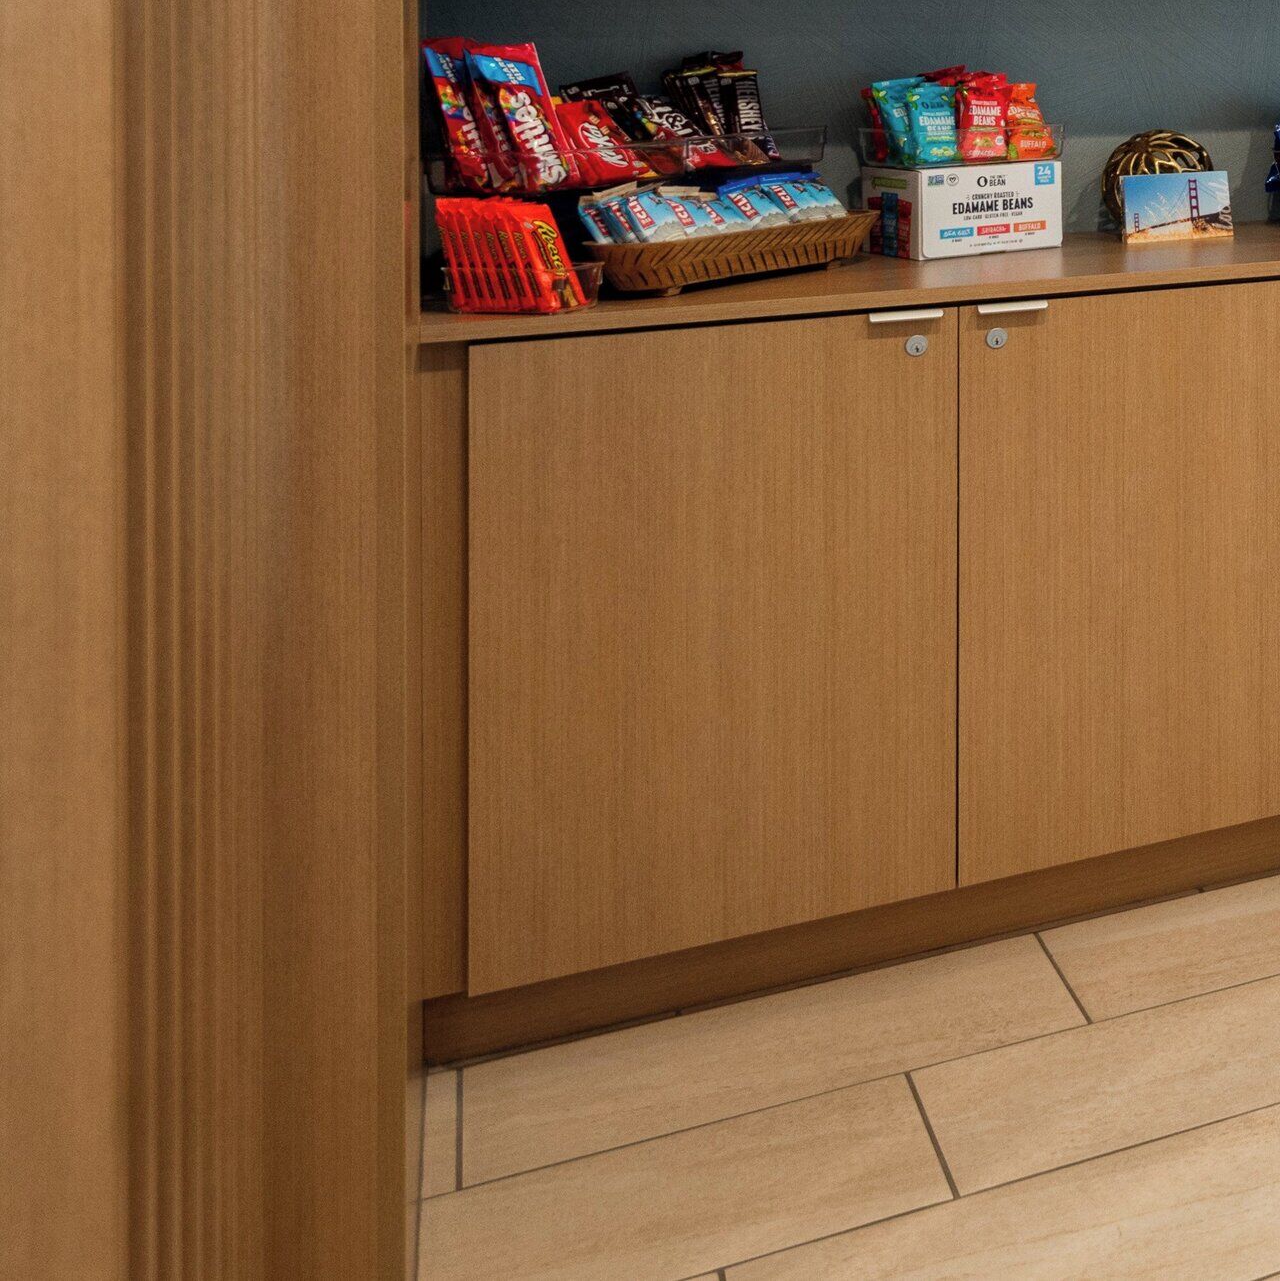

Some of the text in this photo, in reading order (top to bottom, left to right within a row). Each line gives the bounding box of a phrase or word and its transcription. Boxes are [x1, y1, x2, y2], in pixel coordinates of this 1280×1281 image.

[973, 116, 996, 126] BEANS
[1020, 140, 1046, 148] BUFFALO
[1037, 166, 1051, 175] 24
[989, 179, 1006, 187] BEAN
[971, 192, 993, 200] CRUNCHY
[952, 197, 1033, 215] EDAMAME BEANS
